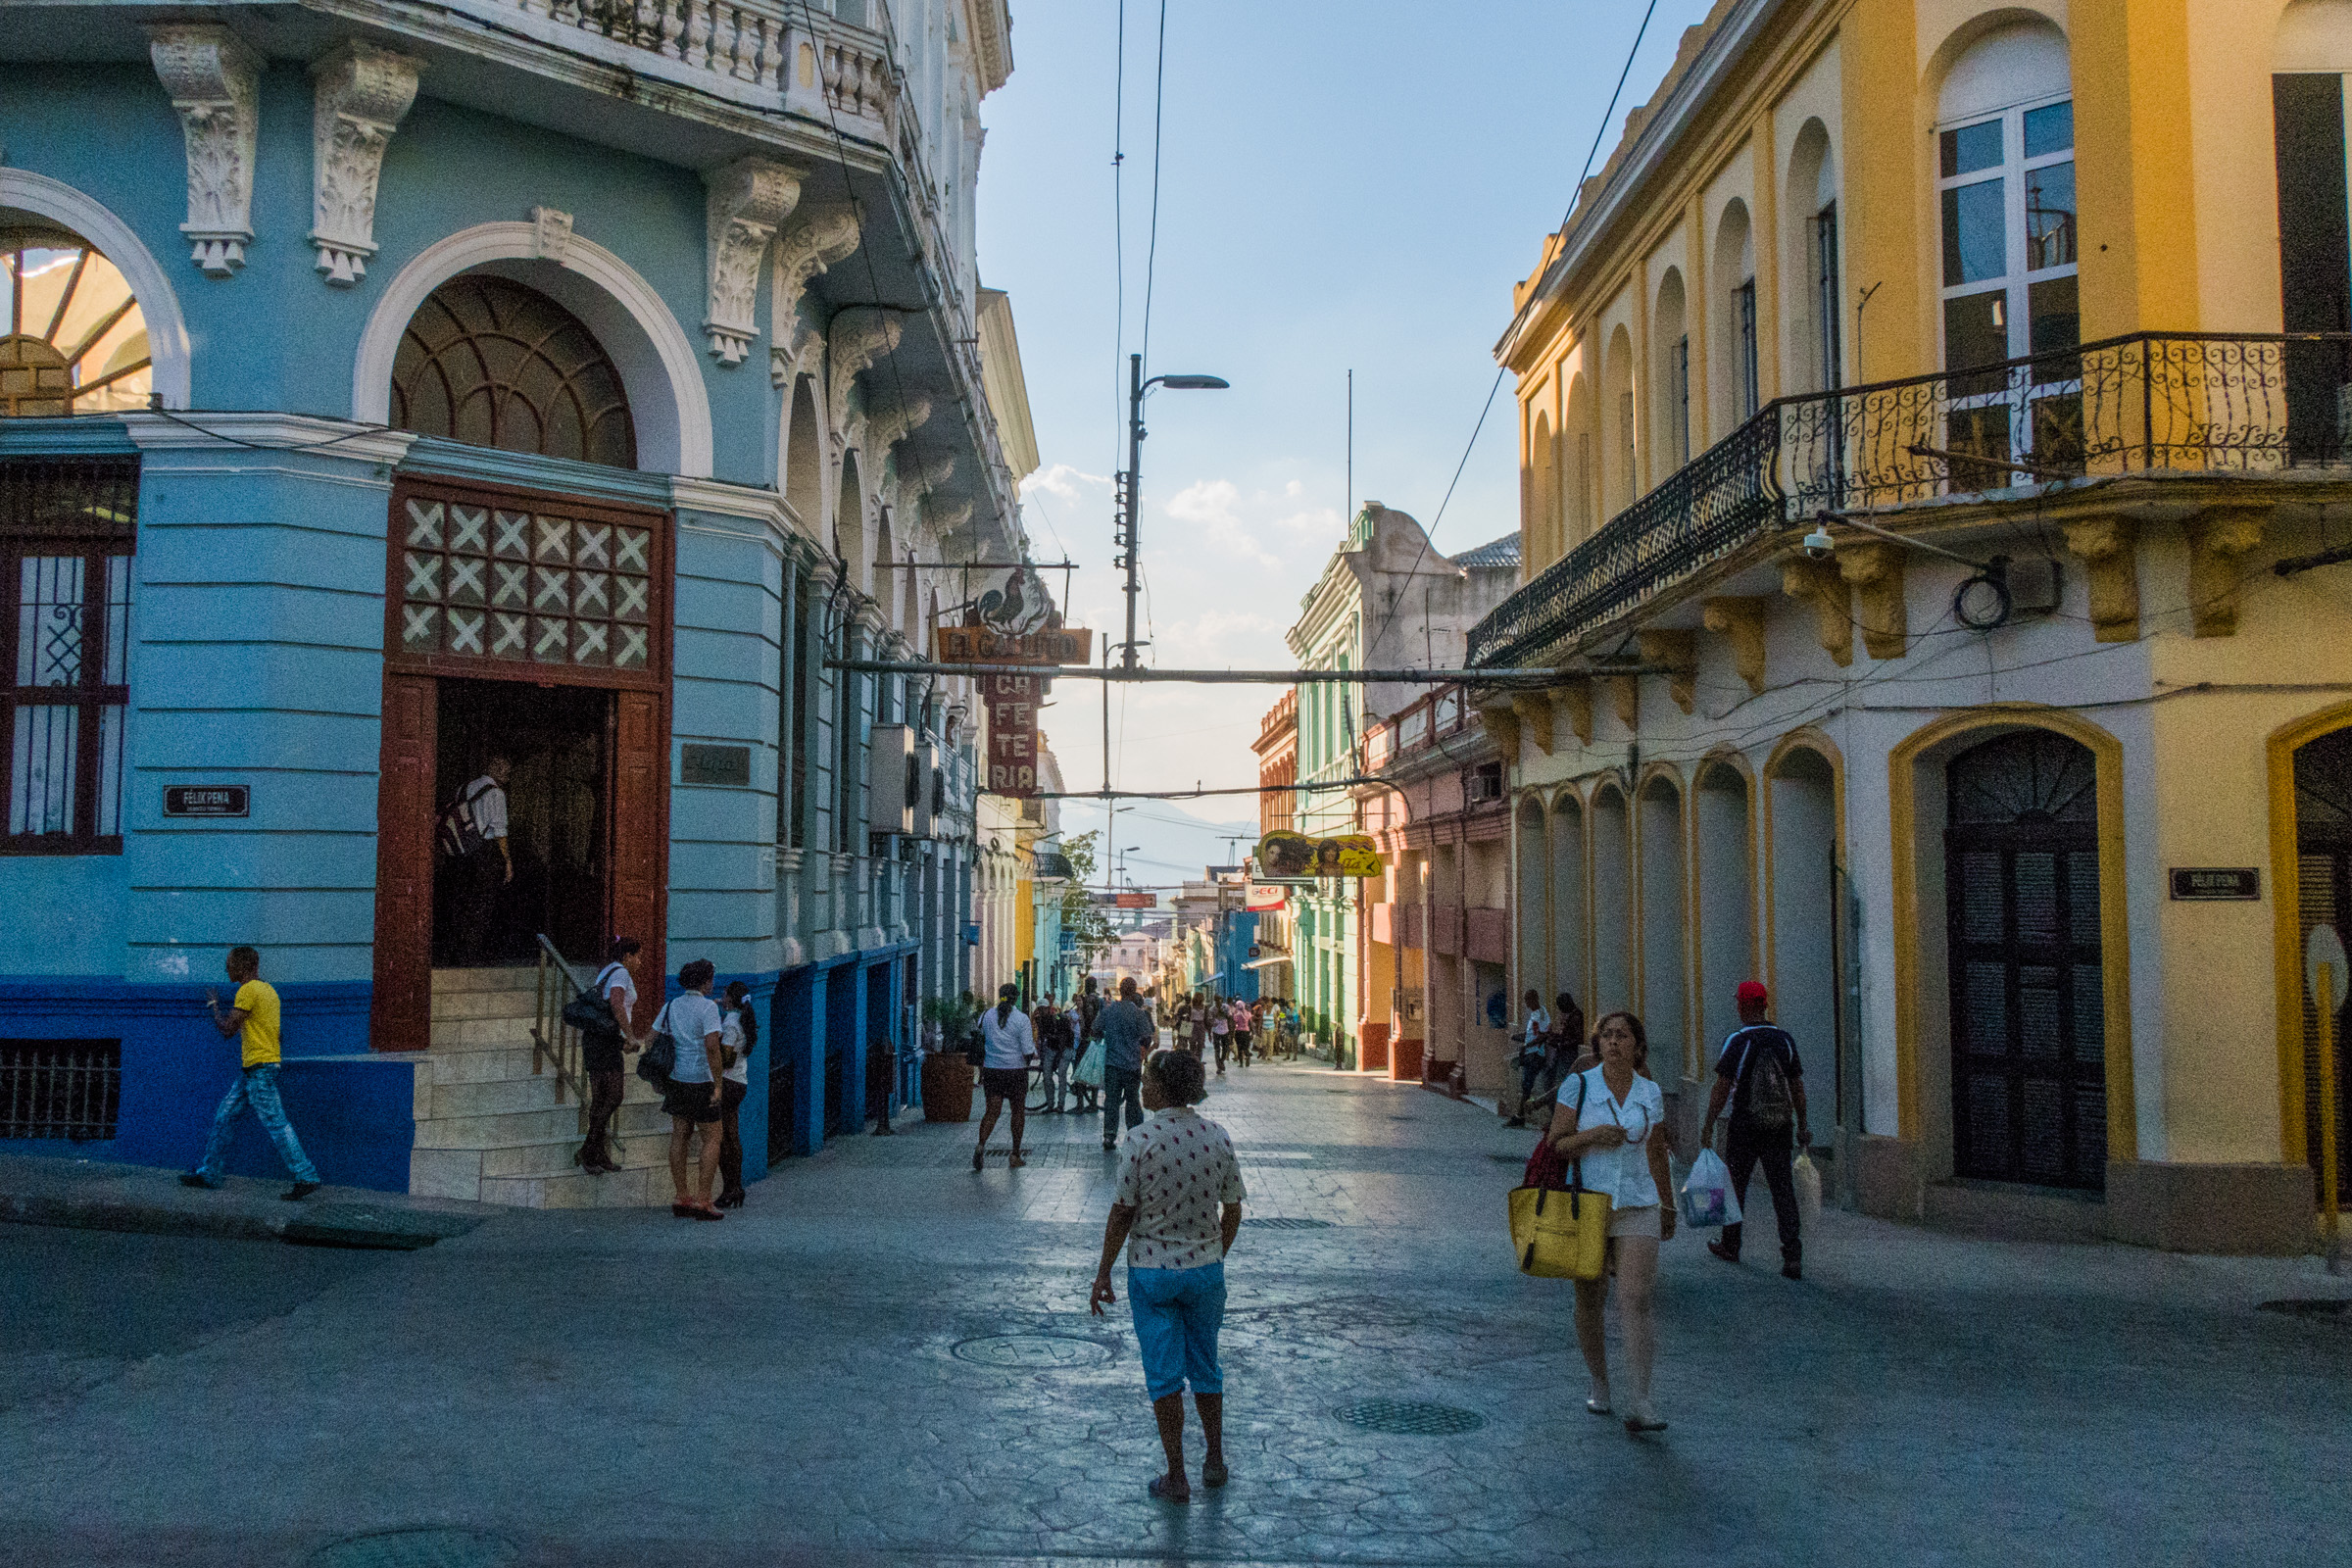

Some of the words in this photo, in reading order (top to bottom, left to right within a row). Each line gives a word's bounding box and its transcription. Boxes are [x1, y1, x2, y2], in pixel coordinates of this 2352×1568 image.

[996, 703, 1030, 725] FE
[996, 734, 1029, 757] TE
[991, 764, 1034, 788] RIA
